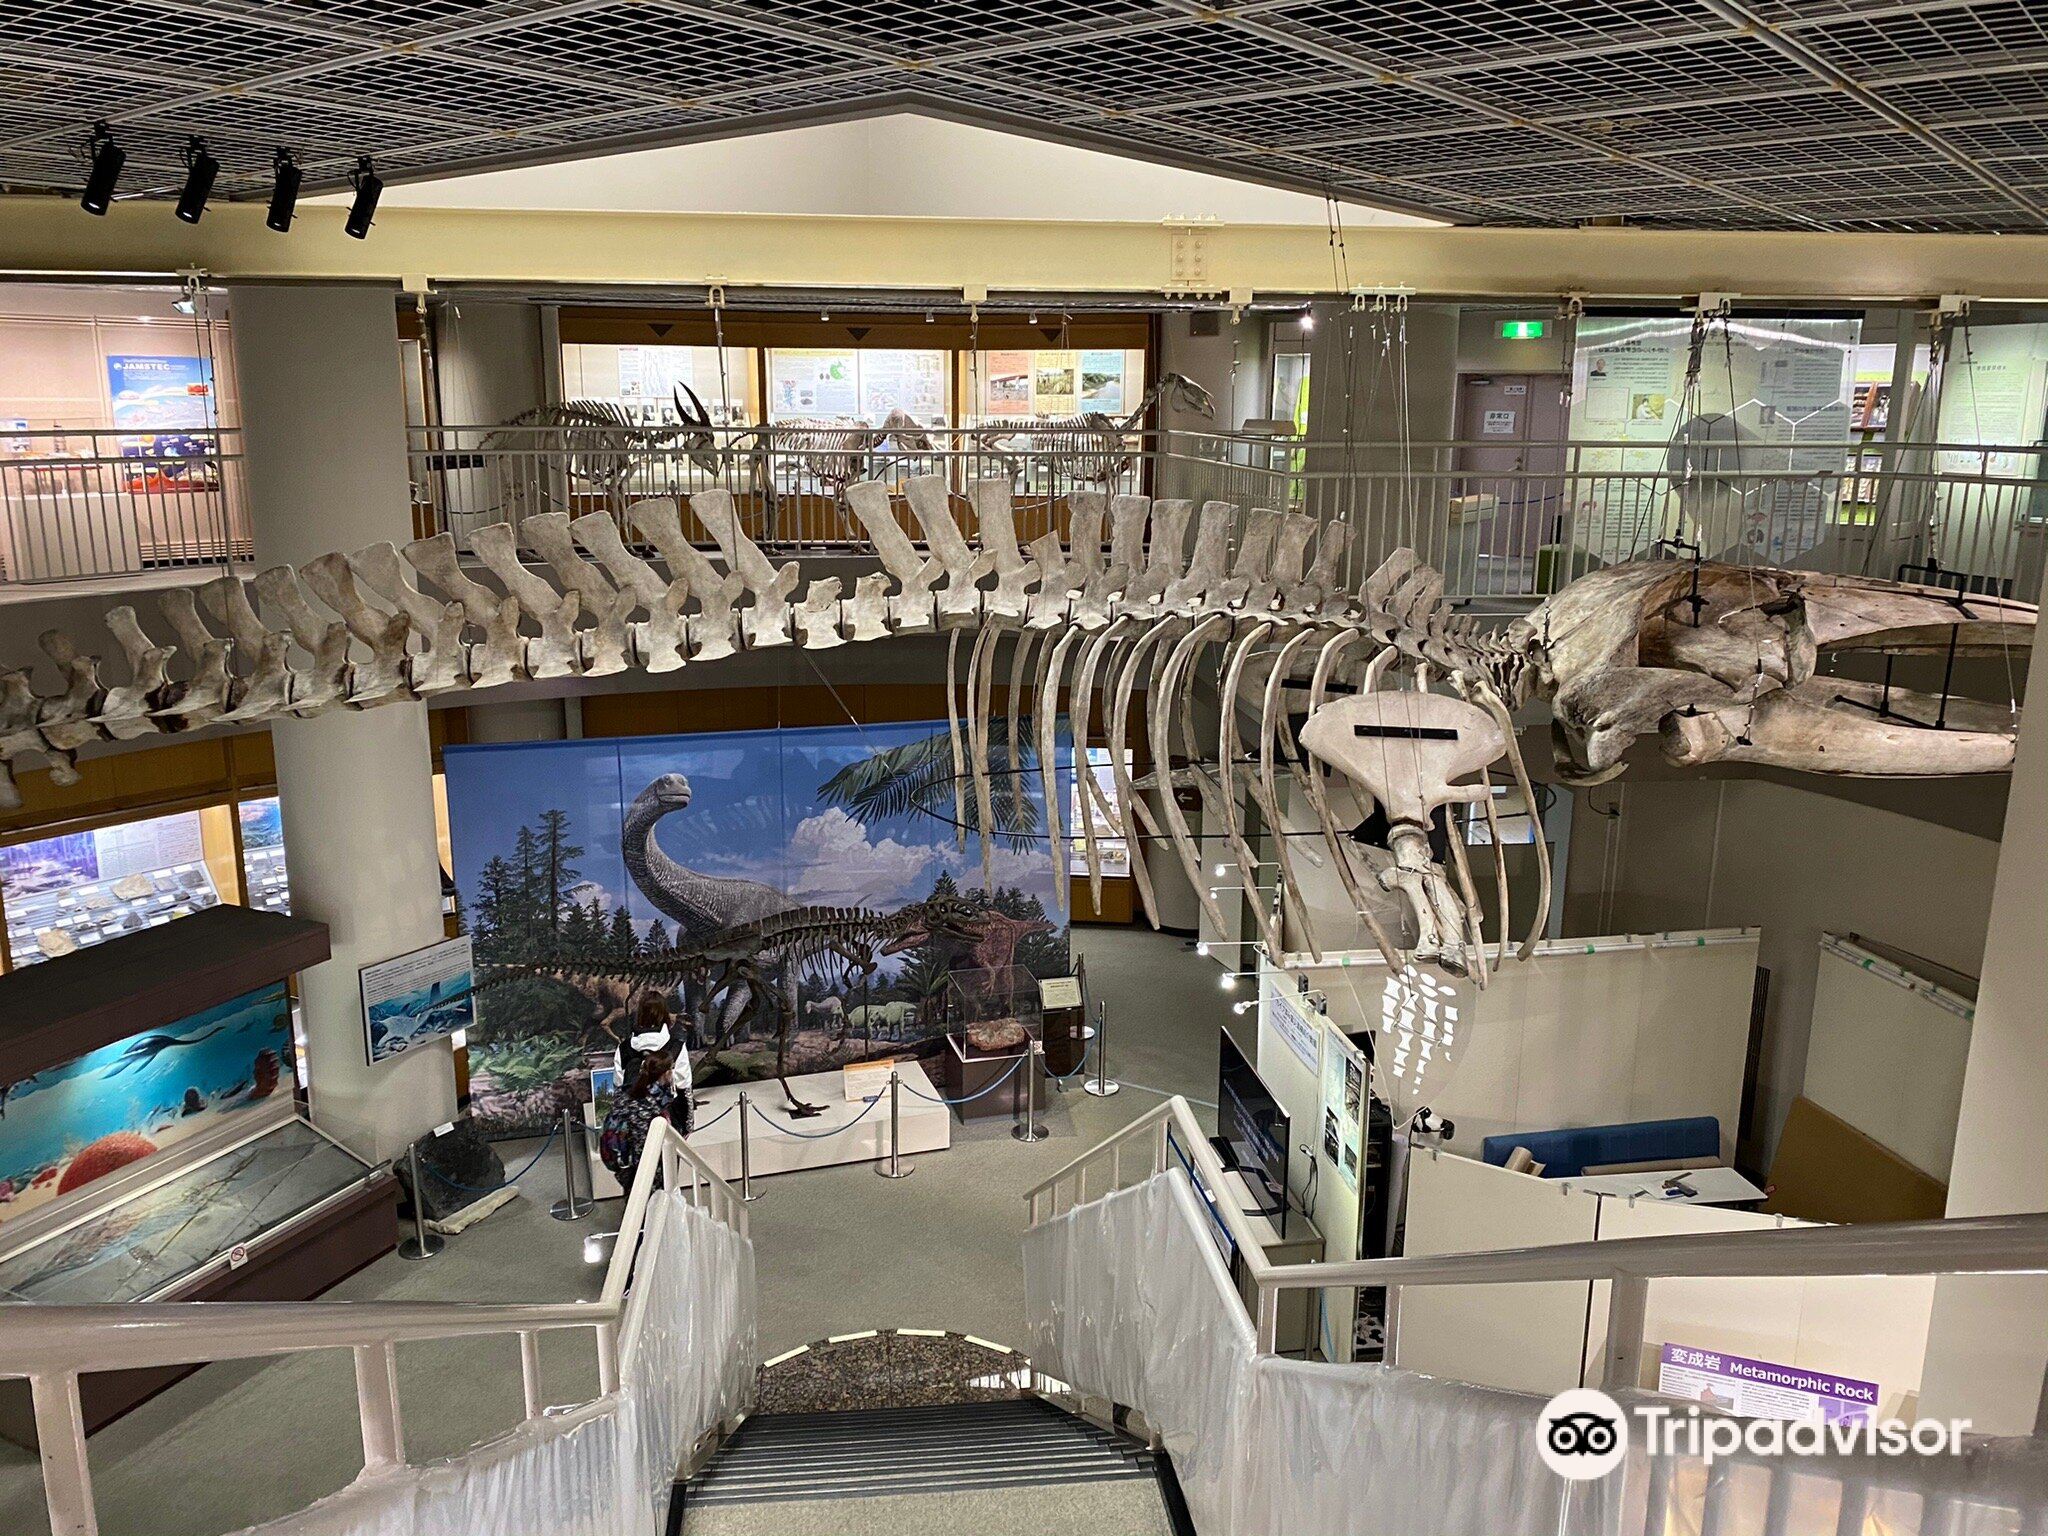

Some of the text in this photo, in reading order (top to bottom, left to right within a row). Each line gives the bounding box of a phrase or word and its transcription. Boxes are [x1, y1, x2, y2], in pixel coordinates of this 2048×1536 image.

[1670, 1347, 1722, 1370] 変成岩
[1730, 1362, 1830, 1393] Metamorphic
[1834, 1383, 1874, 1401] Rock
